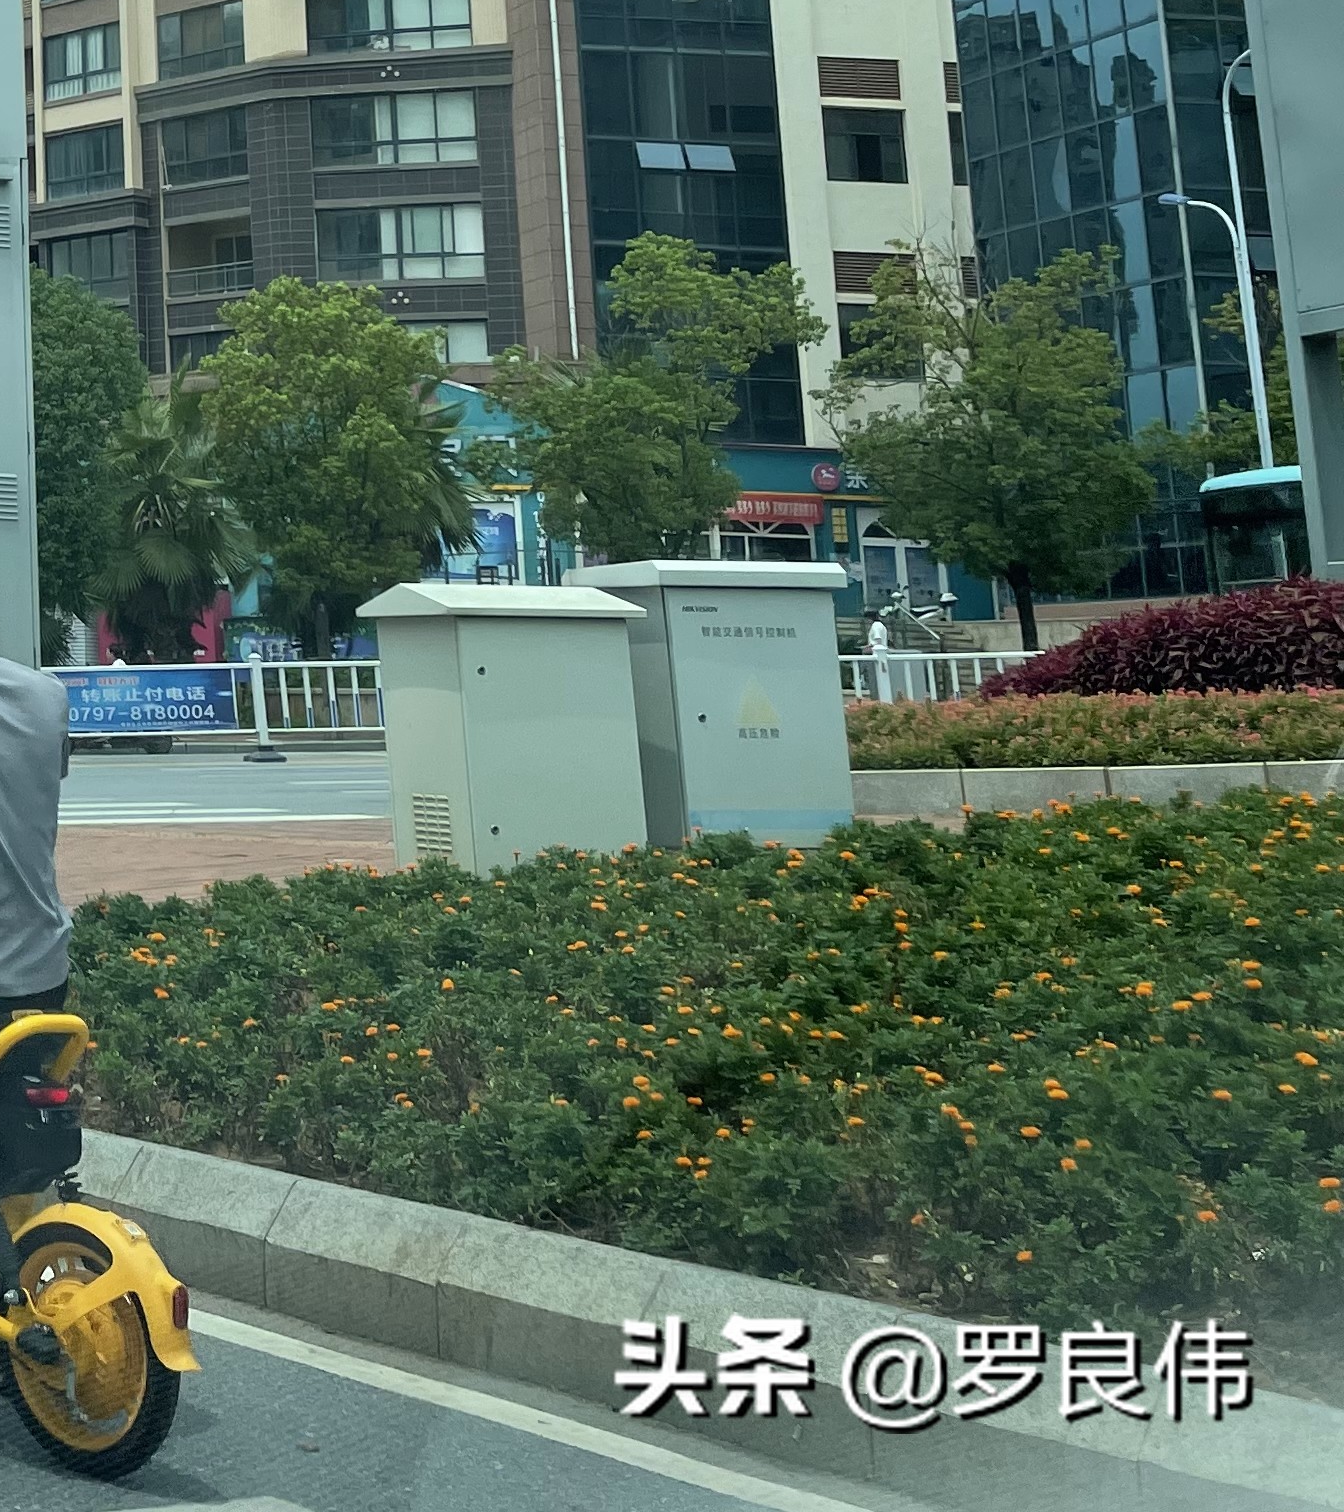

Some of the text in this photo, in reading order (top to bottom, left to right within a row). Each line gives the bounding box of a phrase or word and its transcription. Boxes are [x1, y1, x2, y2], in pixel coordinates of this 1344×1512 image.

[701, 625, 797, 639] 智能交通信号控制机
[81, 686, 206, 704] 转账止付电话
[68, 704, 216, 722] 0797-8180004
